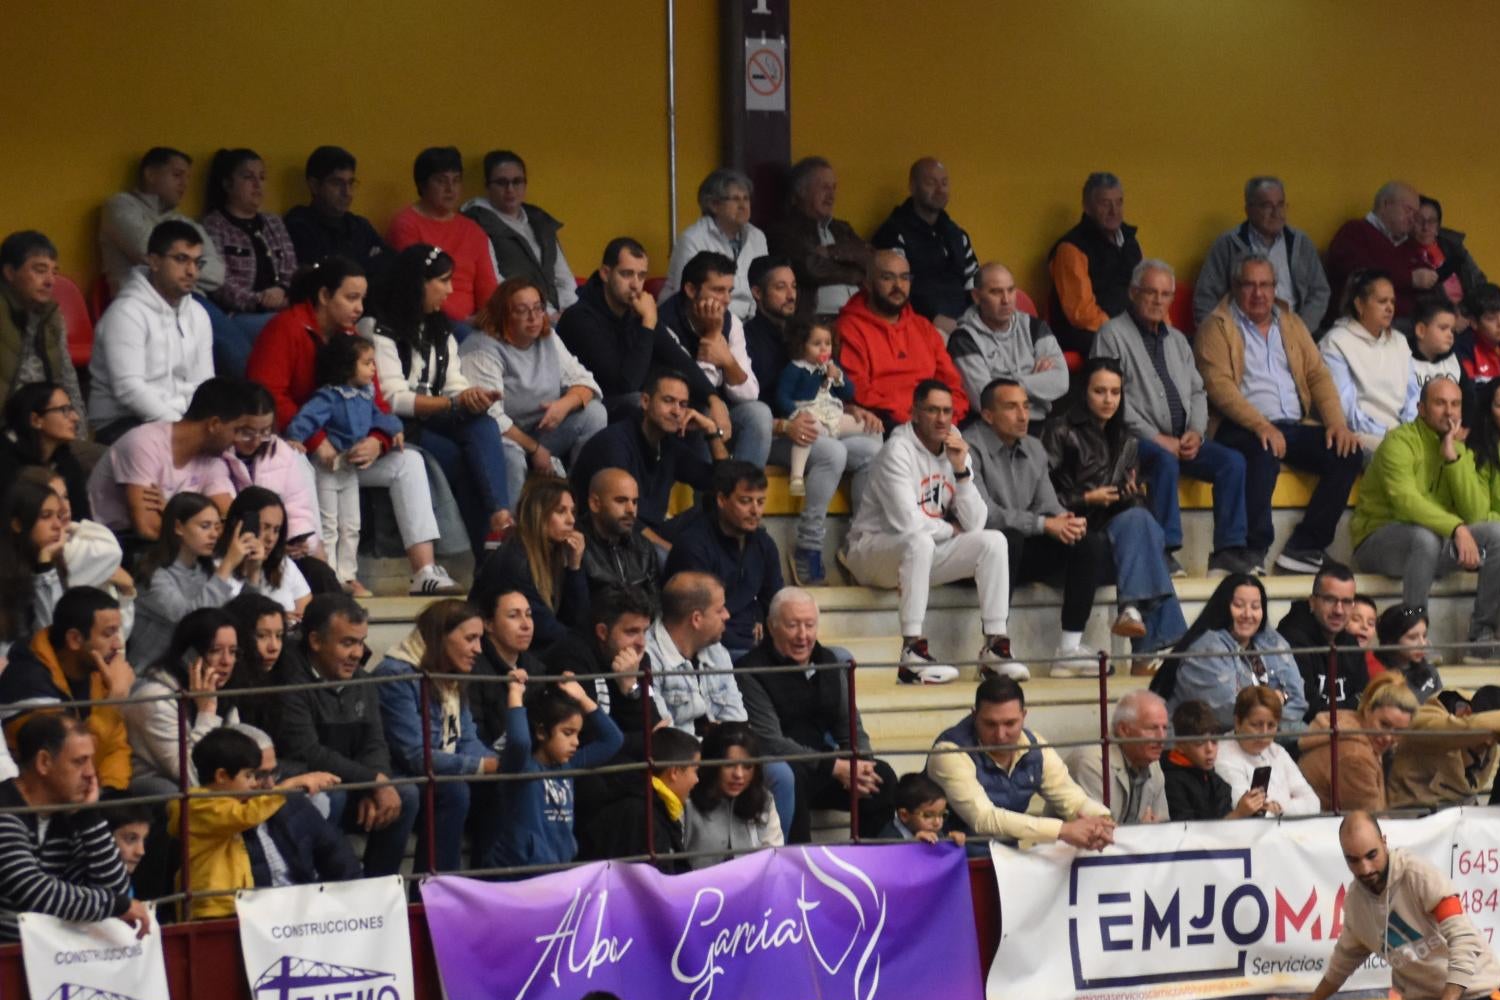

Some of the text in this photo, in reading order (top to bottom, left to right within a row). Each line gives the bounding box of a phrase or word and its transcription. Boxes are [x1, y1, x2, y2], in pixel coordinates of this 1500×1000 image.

[1458, 848, 1499, 875] 645
[271, 915, 384, 940] CONSTRUCCIONES
[1252, 954, 1324, 977] Servicios
